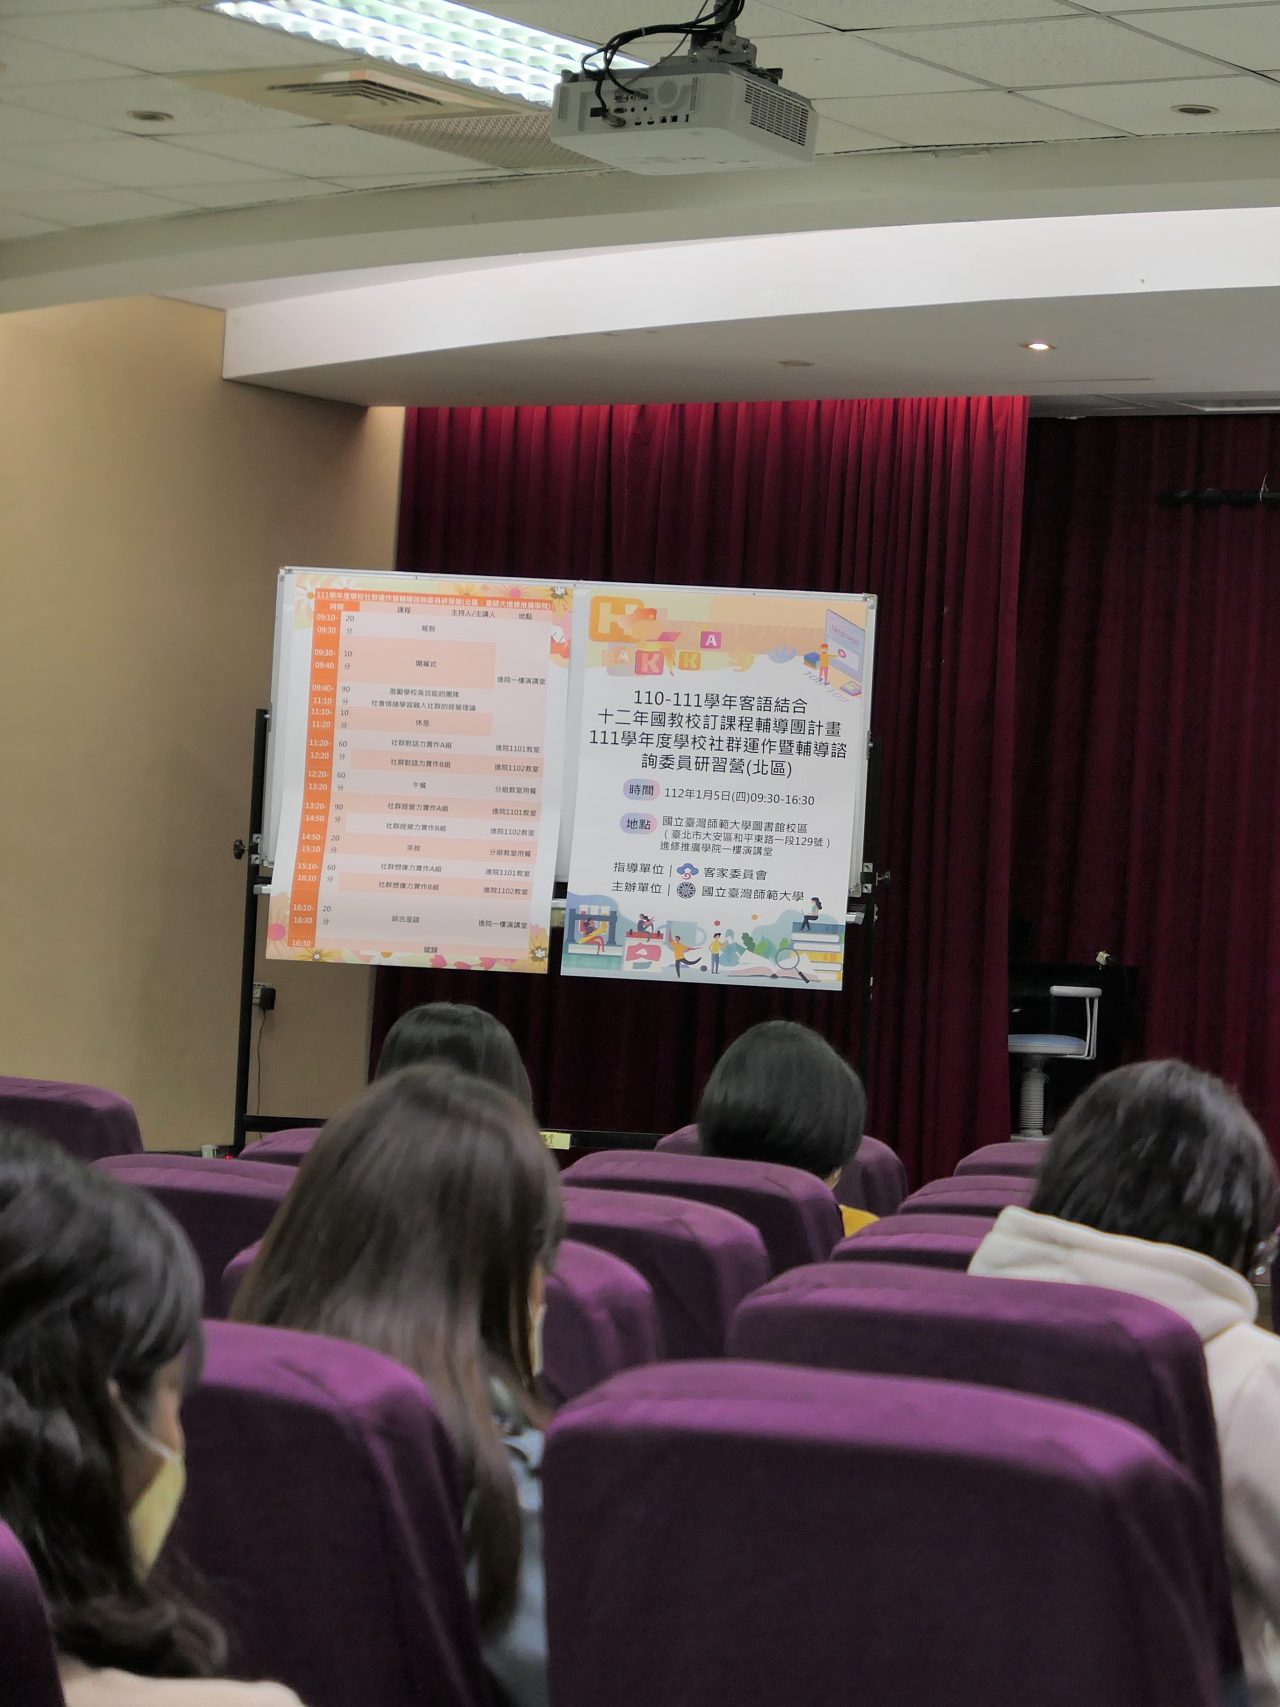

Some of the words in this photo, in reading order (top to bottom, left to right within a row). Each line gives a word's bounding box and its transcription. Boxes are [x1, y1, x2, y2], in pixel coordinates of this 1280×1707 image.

[634, 690, 808, 714] 110-111學年客語結合
[598, 708, 842, 737] 十二年國教校訂課程輔導團計畫
[589, 730, 847, 759] 111學年度學校社群運作暨輔導諮
[641, 753, 792, 778] 詢委員研習營(北區)
[629, 784, 654, 797] 時間
[664, 788, 815, 806] 112年1月5日(四)09:30-16:30
[626, 818, 651, 831] 地點
[662, 816, 808, 834] 國立臺灣師範大學圖書館校區
[659, 841, 773, 857] 進修推廣學院一樓演講堂
[613, 862, 664, 875] 指導單位
[703, 867, 768, 881] 客家委員會
[611, 881, 662, 894] 主辦單位
[702, 885, 804, 901] 國立臺灣師範大學
